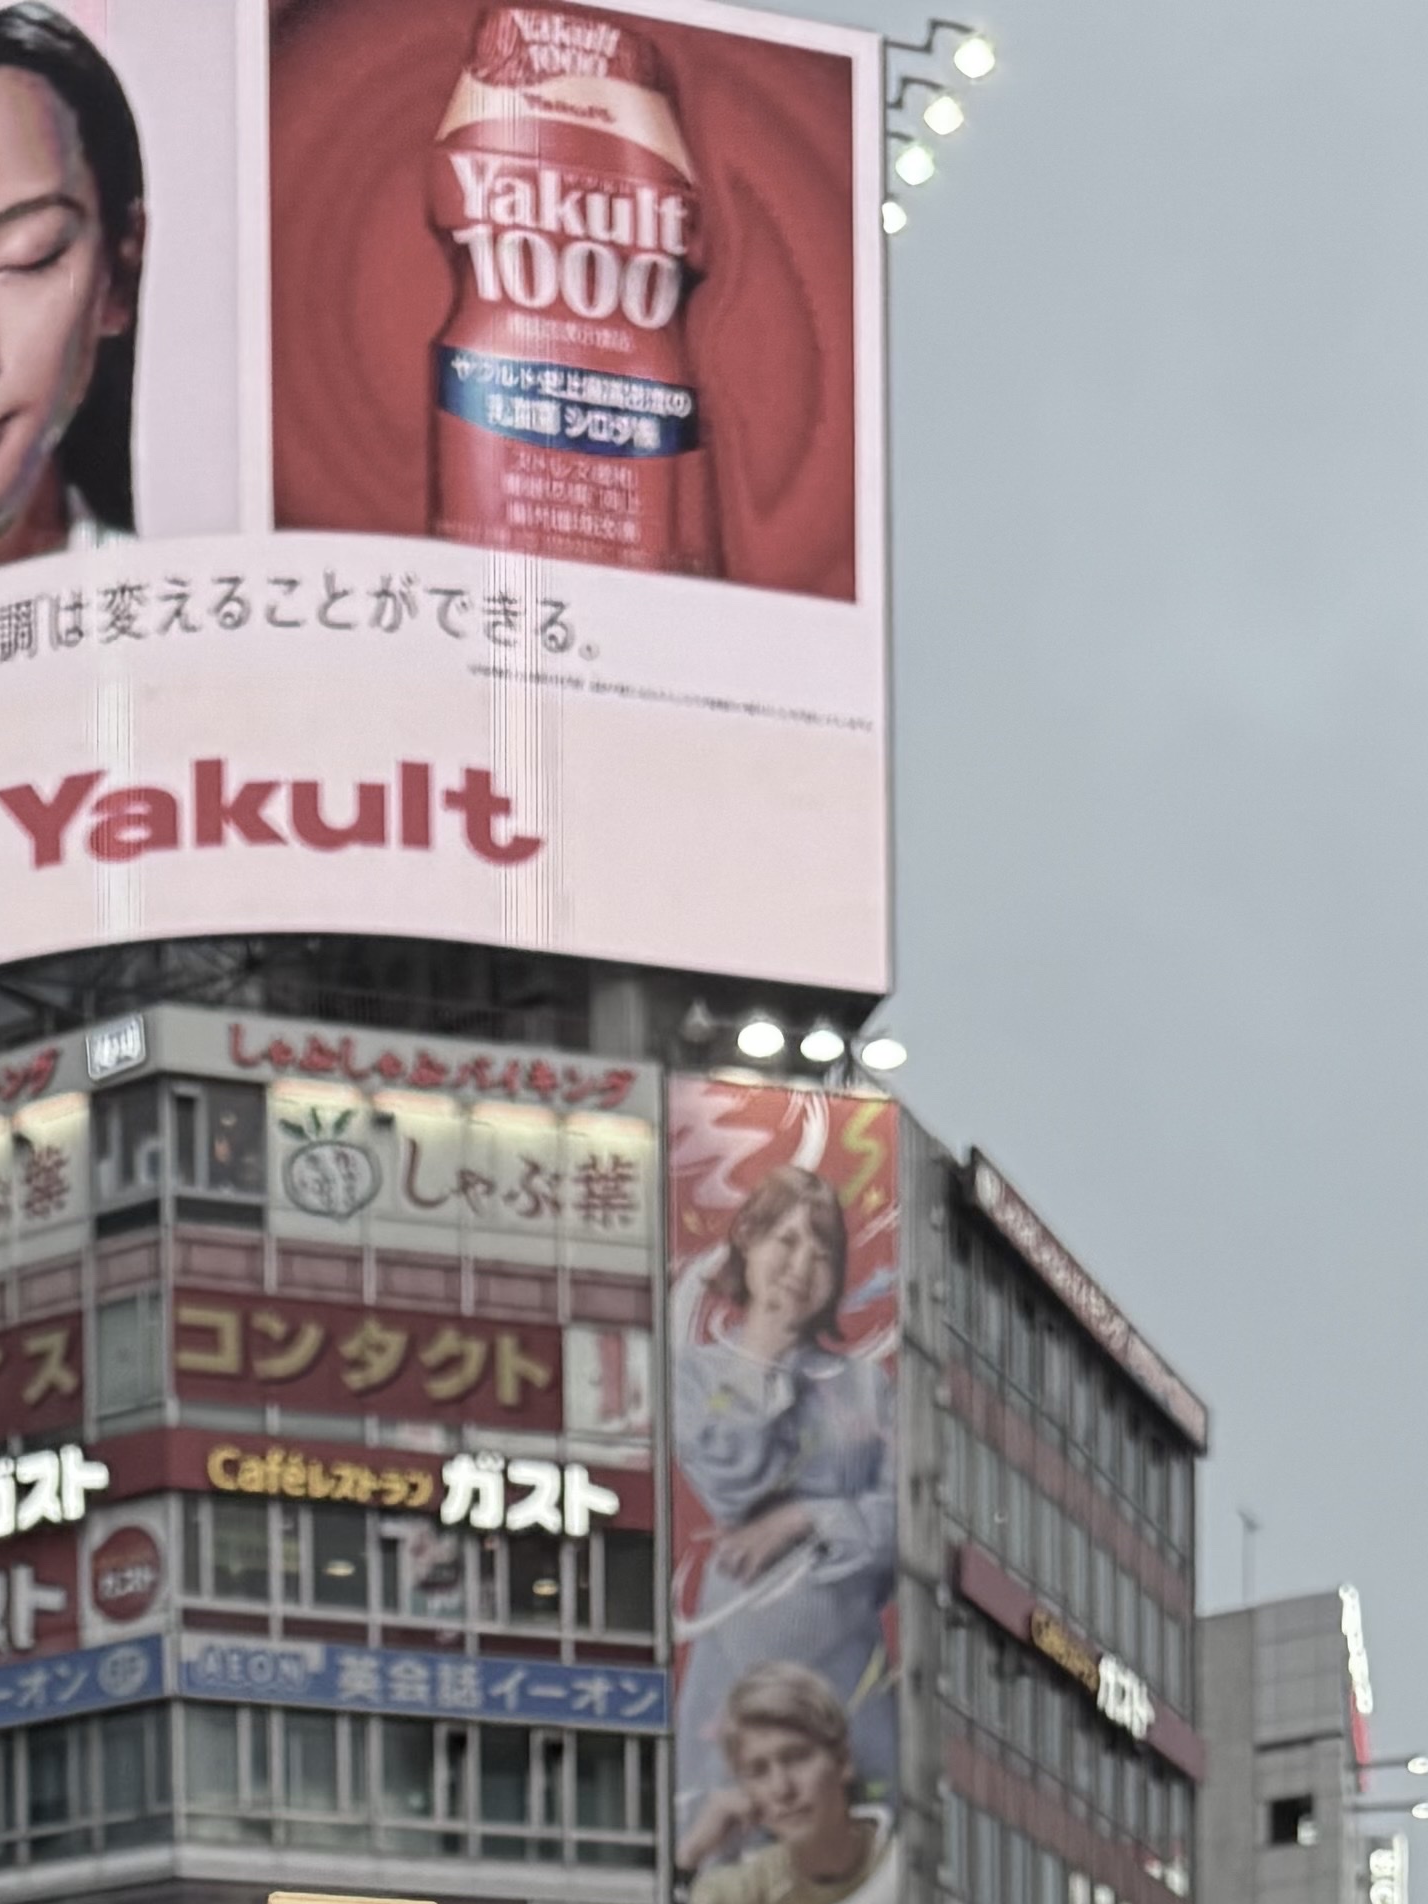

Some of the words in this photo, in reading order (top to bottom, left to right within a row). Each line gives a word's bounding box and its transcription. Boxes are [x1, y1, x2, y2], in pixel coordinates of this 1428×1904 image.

[449, 153, 689, 256] Yakult
[454, 224, 682, 330] 1000
[402, 1137, 638, 1230] しゃぶ葉
[176, 1308, 553, 1406] コンタクト
[439, 1449, 621, 1537] ガスト
[336, 1655, 660, 1720] 英会話イーオン
